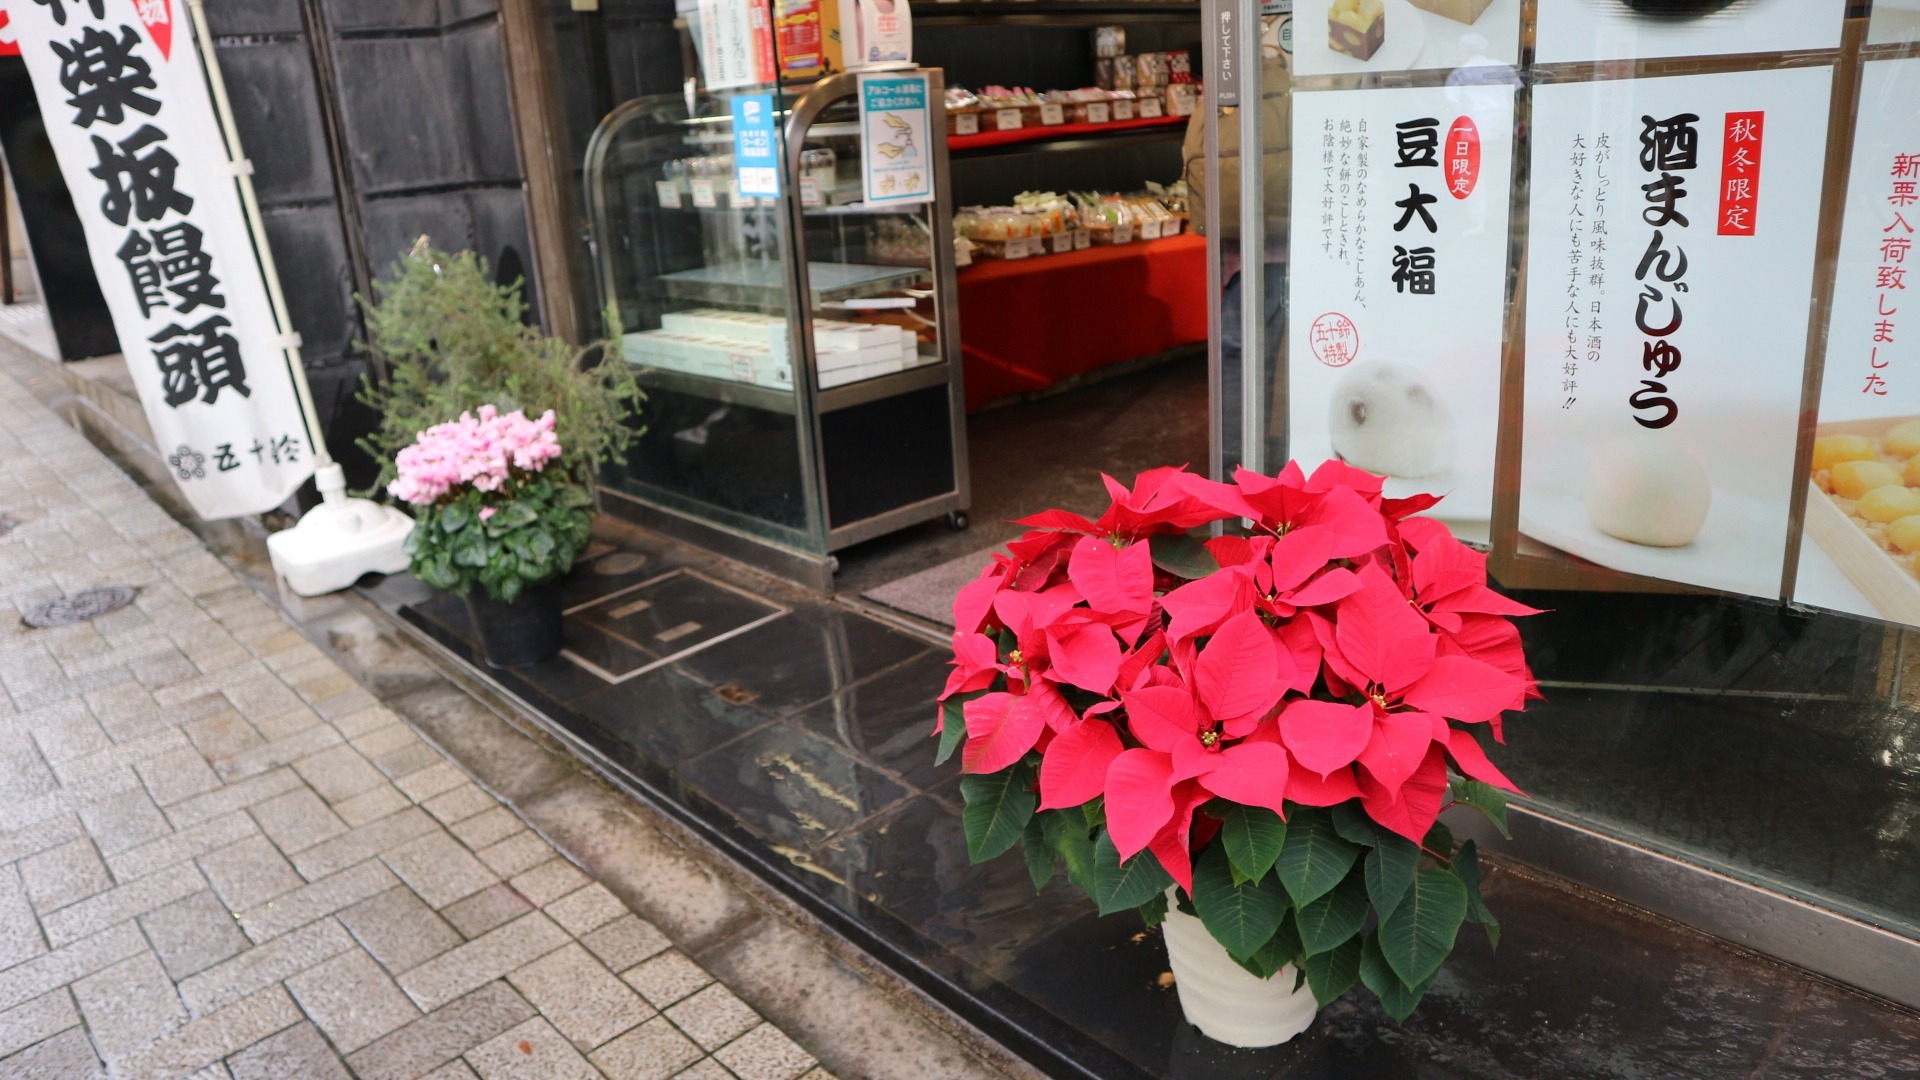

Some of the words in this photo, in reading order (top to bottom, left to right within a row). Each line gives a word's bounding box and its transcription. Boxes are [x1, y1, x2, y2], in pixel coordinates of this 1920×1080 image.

[1221, 11, 1232, 80] 押して下さい
[33, 0, 251, 408] 楽坂饅頭
[1321, 118, 1335, 260] お陰様で大好評です。
[1354, 118, 1369, 309] 自家製のなめらかなこしあん、
[1391, 117, 1441, 295] 豆大福
[1451, 126, 1471, 194] 一日限定
[1724, 118, 1758, 230] 秋冬限定
[1587, 132, 1610, 362] 皮がしっとり風味抜群。日本酒の
[1629, 113, 1700, 429] 酒まんじゅう
[1862, 153, 1920, 396] 新栗入荷致しました
[1315, 320, 1351, 342] 五十鈴
[1324, 344, 1350, 363] 特製
